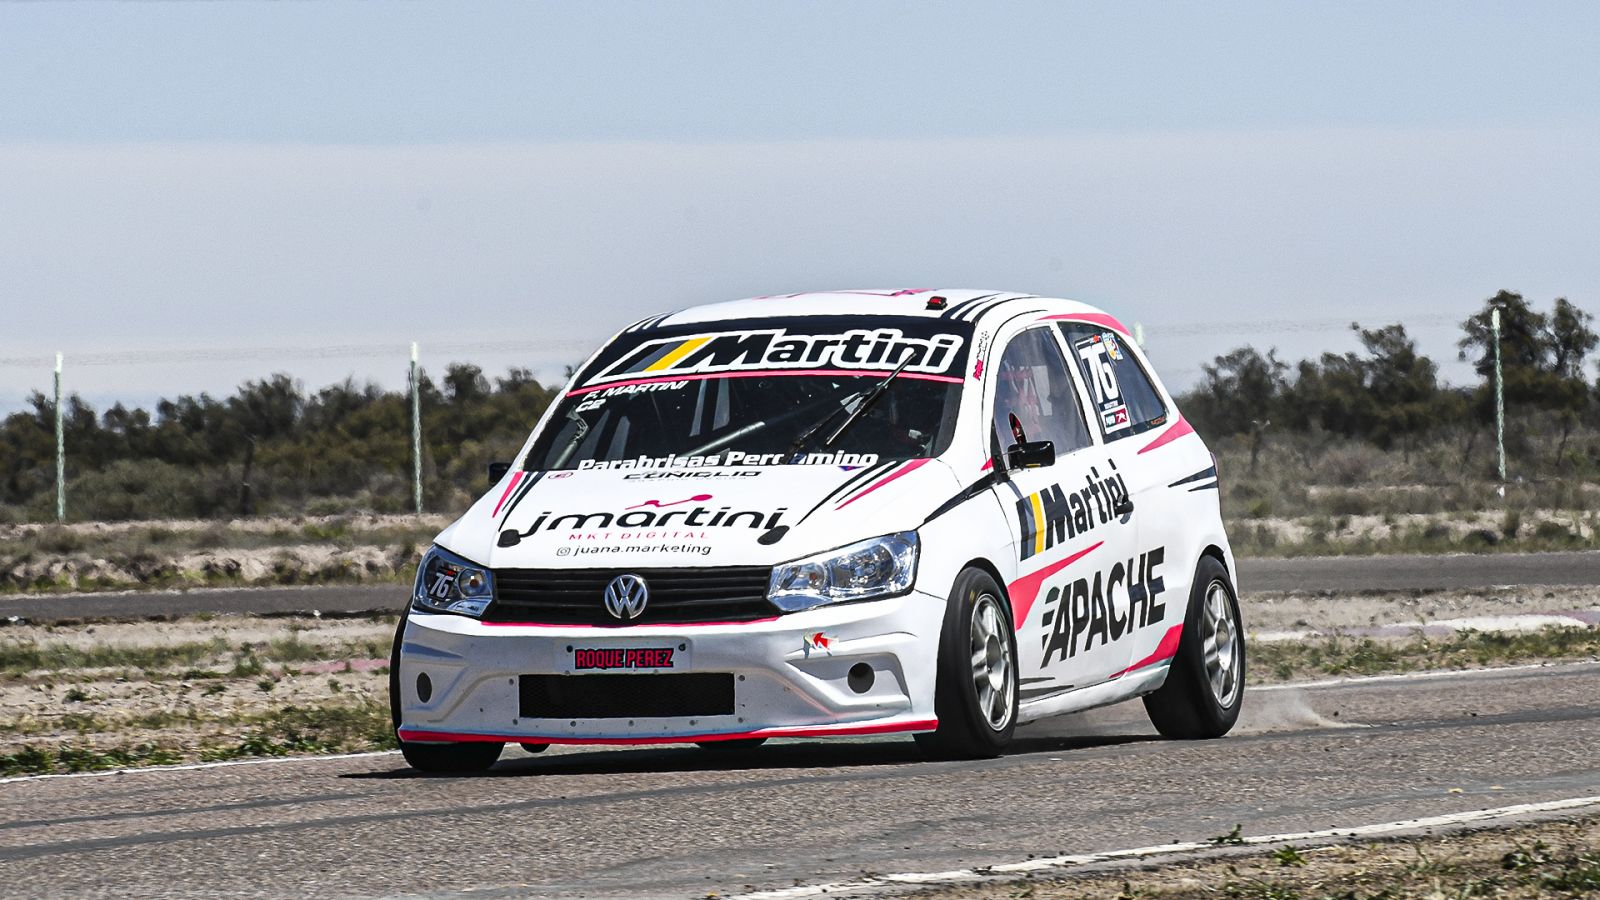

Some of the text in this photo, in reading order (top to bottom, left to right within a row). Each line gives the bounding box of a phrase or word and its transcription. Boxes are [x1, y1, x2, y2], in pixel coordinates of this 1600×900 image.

[685, 330, 958, 372] Martini
[1078, 341, 1120, 404] 76
[600, 380, 690, 398] MARTINI
[577, 453, 721, 471] Parabrisas
[1040, 458, 1130, 551] Martini
[568, 530, 709, 541] MKT DIGITAL
[429, 572, 455, 599] 76
[1040, 546, 1166, 670] APACHE
[575, 648, 674, 669] ROQUE PEREZ
